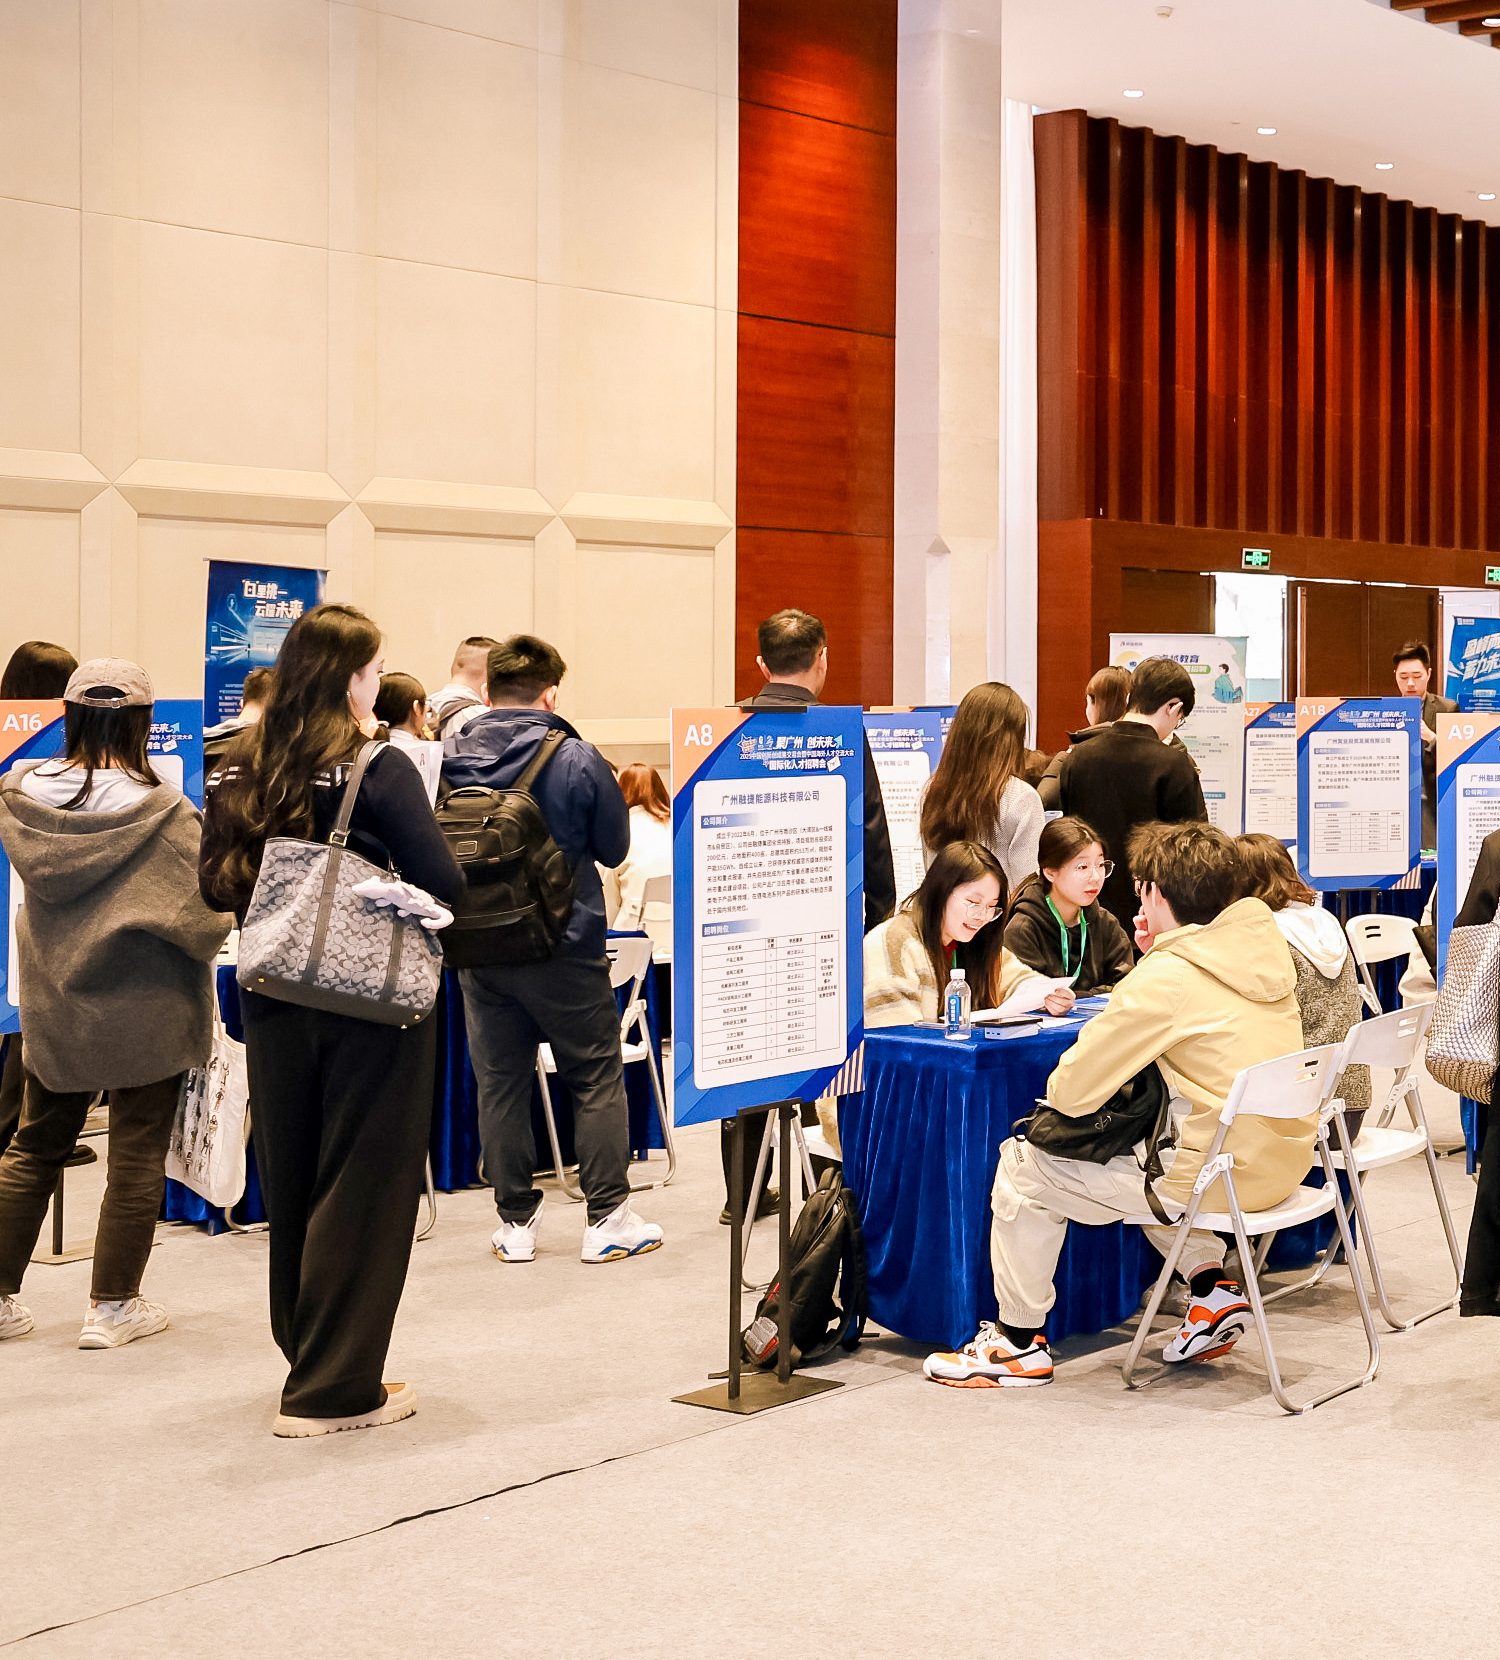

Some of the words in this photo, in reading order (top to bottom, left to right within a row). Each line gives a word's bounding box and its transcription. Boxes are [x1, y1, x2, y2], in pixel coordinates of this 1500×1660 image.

[1300, 705, 1326, 717] A18
[2, 713, 43, 731] A16
[150, 723, 173, 733] 未来
[684, 724, 713, 746] A8
[1448, 725, 1475, 740] A9
[807, 736, 837, 748] 创未来
[769, 759, 827, 771] 国际化人才招聘会
[721, 790, 820, 806] 广州融捷能源科技有限公司
[703, 816, 729, 826] 公司简介
[704, 924, 730, 936] 招聘岗位
